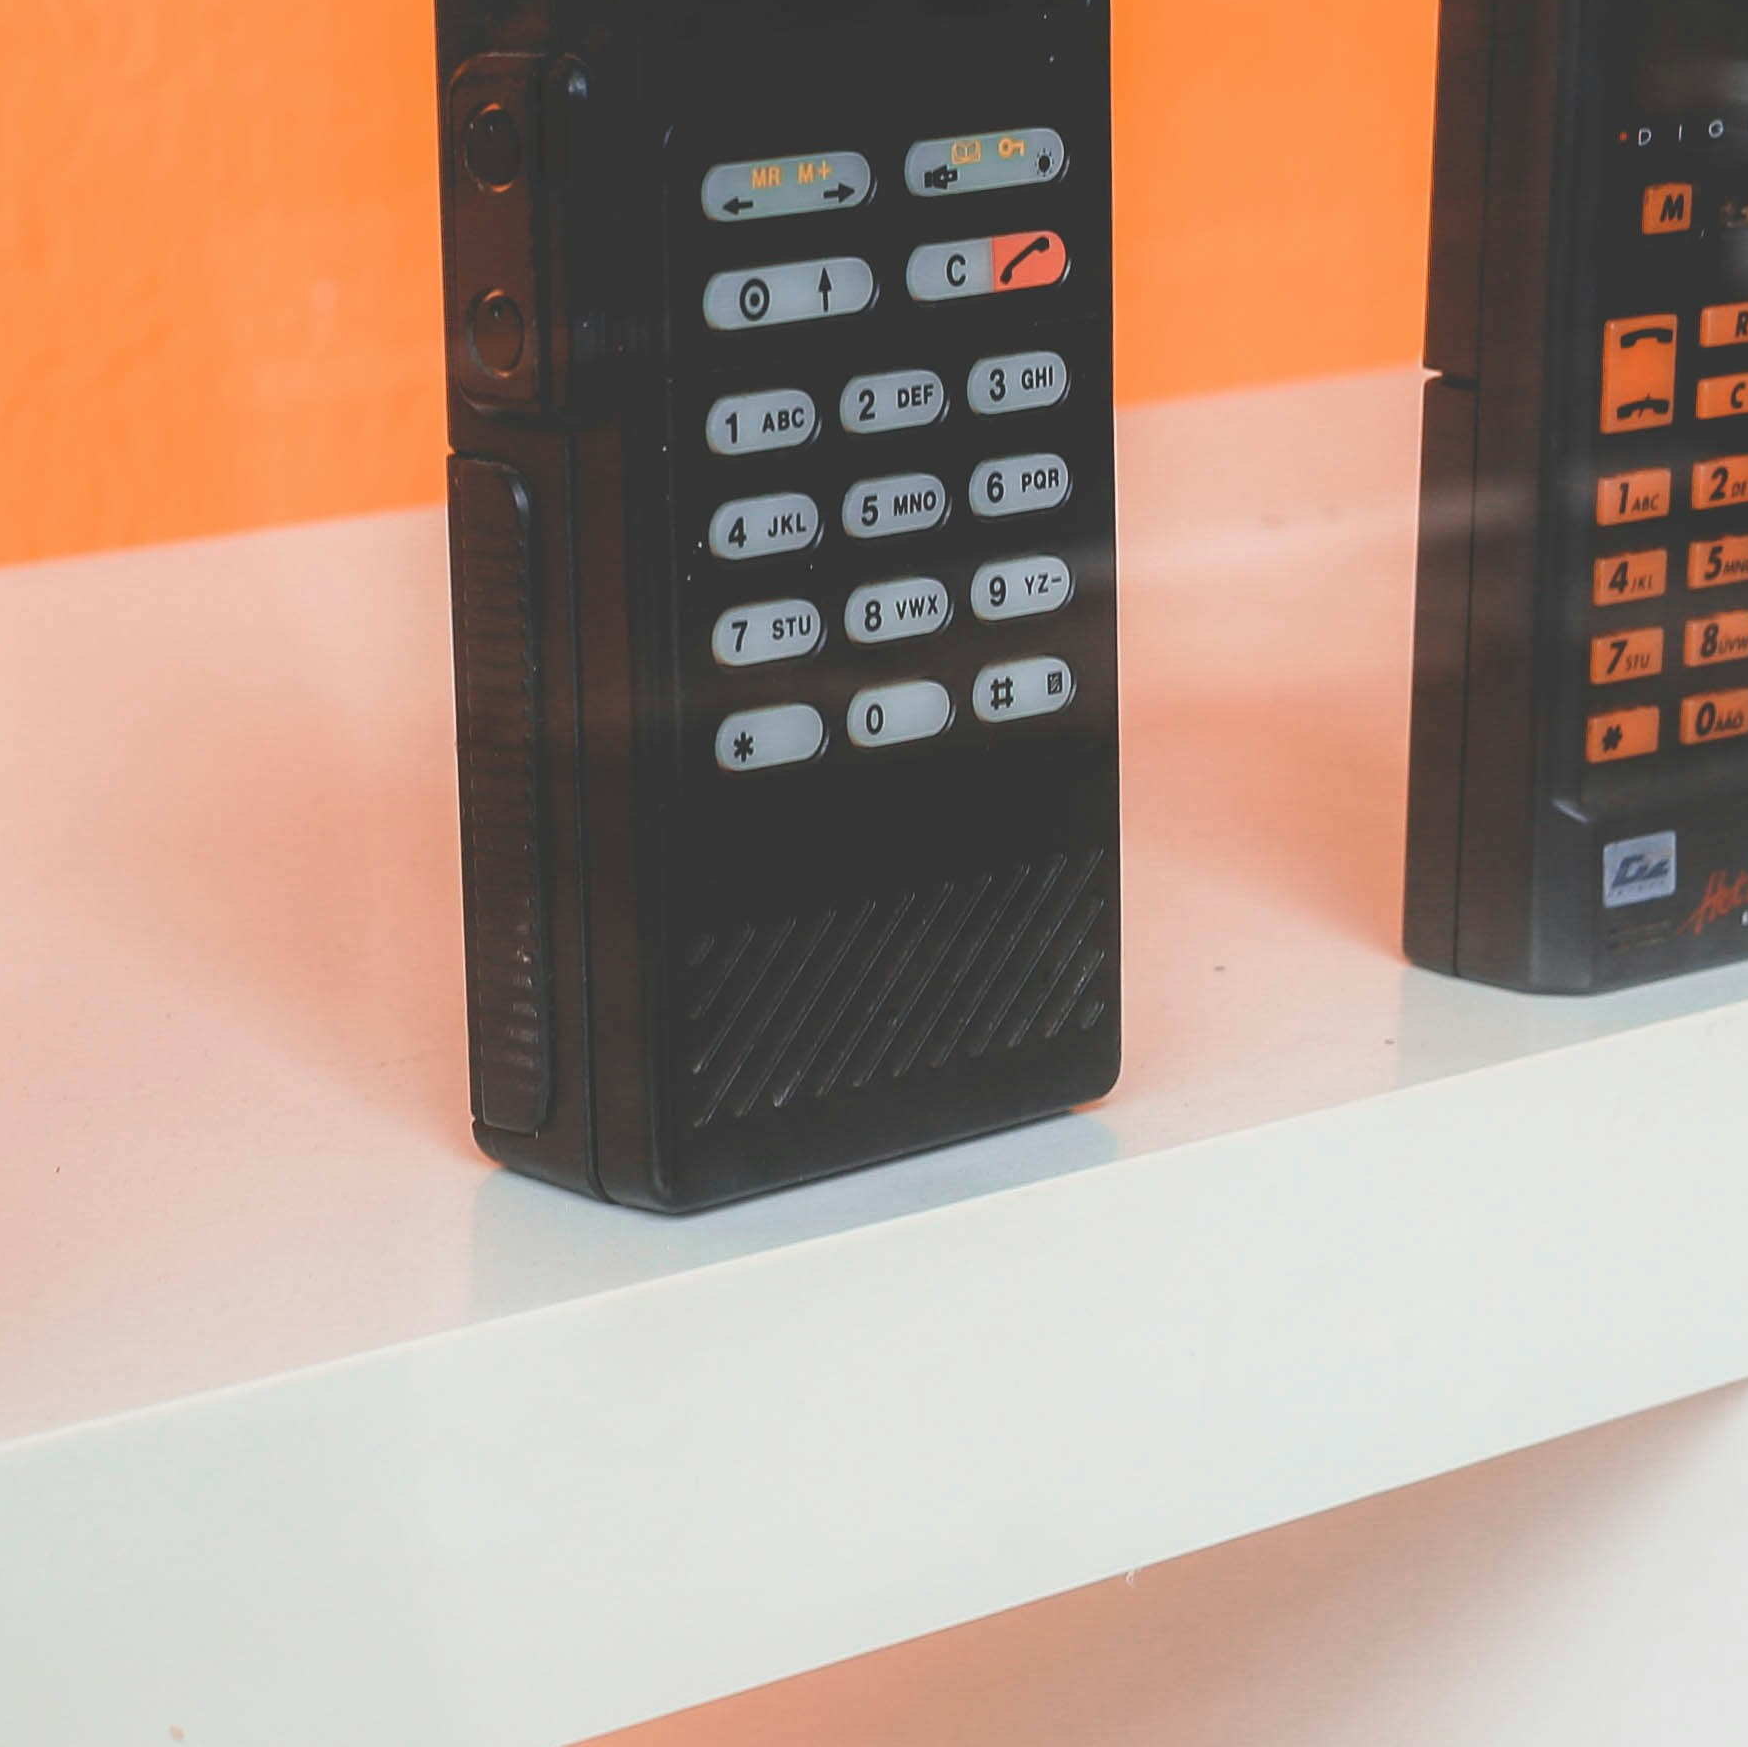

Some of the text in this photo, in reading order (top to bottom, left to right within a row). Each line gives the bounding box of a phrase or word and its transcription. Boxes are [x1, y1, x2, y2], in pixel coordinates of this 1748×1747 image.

[752, 161, 833, 189] MR M+
[1660, 194, 1684, 223] M
[946, 254, 967, 287] C
[989, 366, 1054, 401] 3 GHI
[1730, 381, 1746, 409] C
[858, 384, 934, 422] 2 DEF
[725, 408, 805, 443] 1 ABC
[986, 468, 1059, 503] 6 PQR
[1618, 482, 1629, 514] 1
[1708, 467, 1728, 501] 2
[861, 490, 937, 527] 5 MNO
[728, 512, 807, 548] 4 JKL
[1608, 560, 1629, 594] 4
[1704, 545, 1723, 581] 5
[989, 577, 1006, 606] 9
[864, 594, 939, 632] 8 VWX
[731, 616, 811, 653] 7 STU
[1701, 623, 1719, 657] 8
[1606, 640, 1627, 675] 7
[865, 703, 883, 734] 0
[1696, 702, 1715, 735] 0
